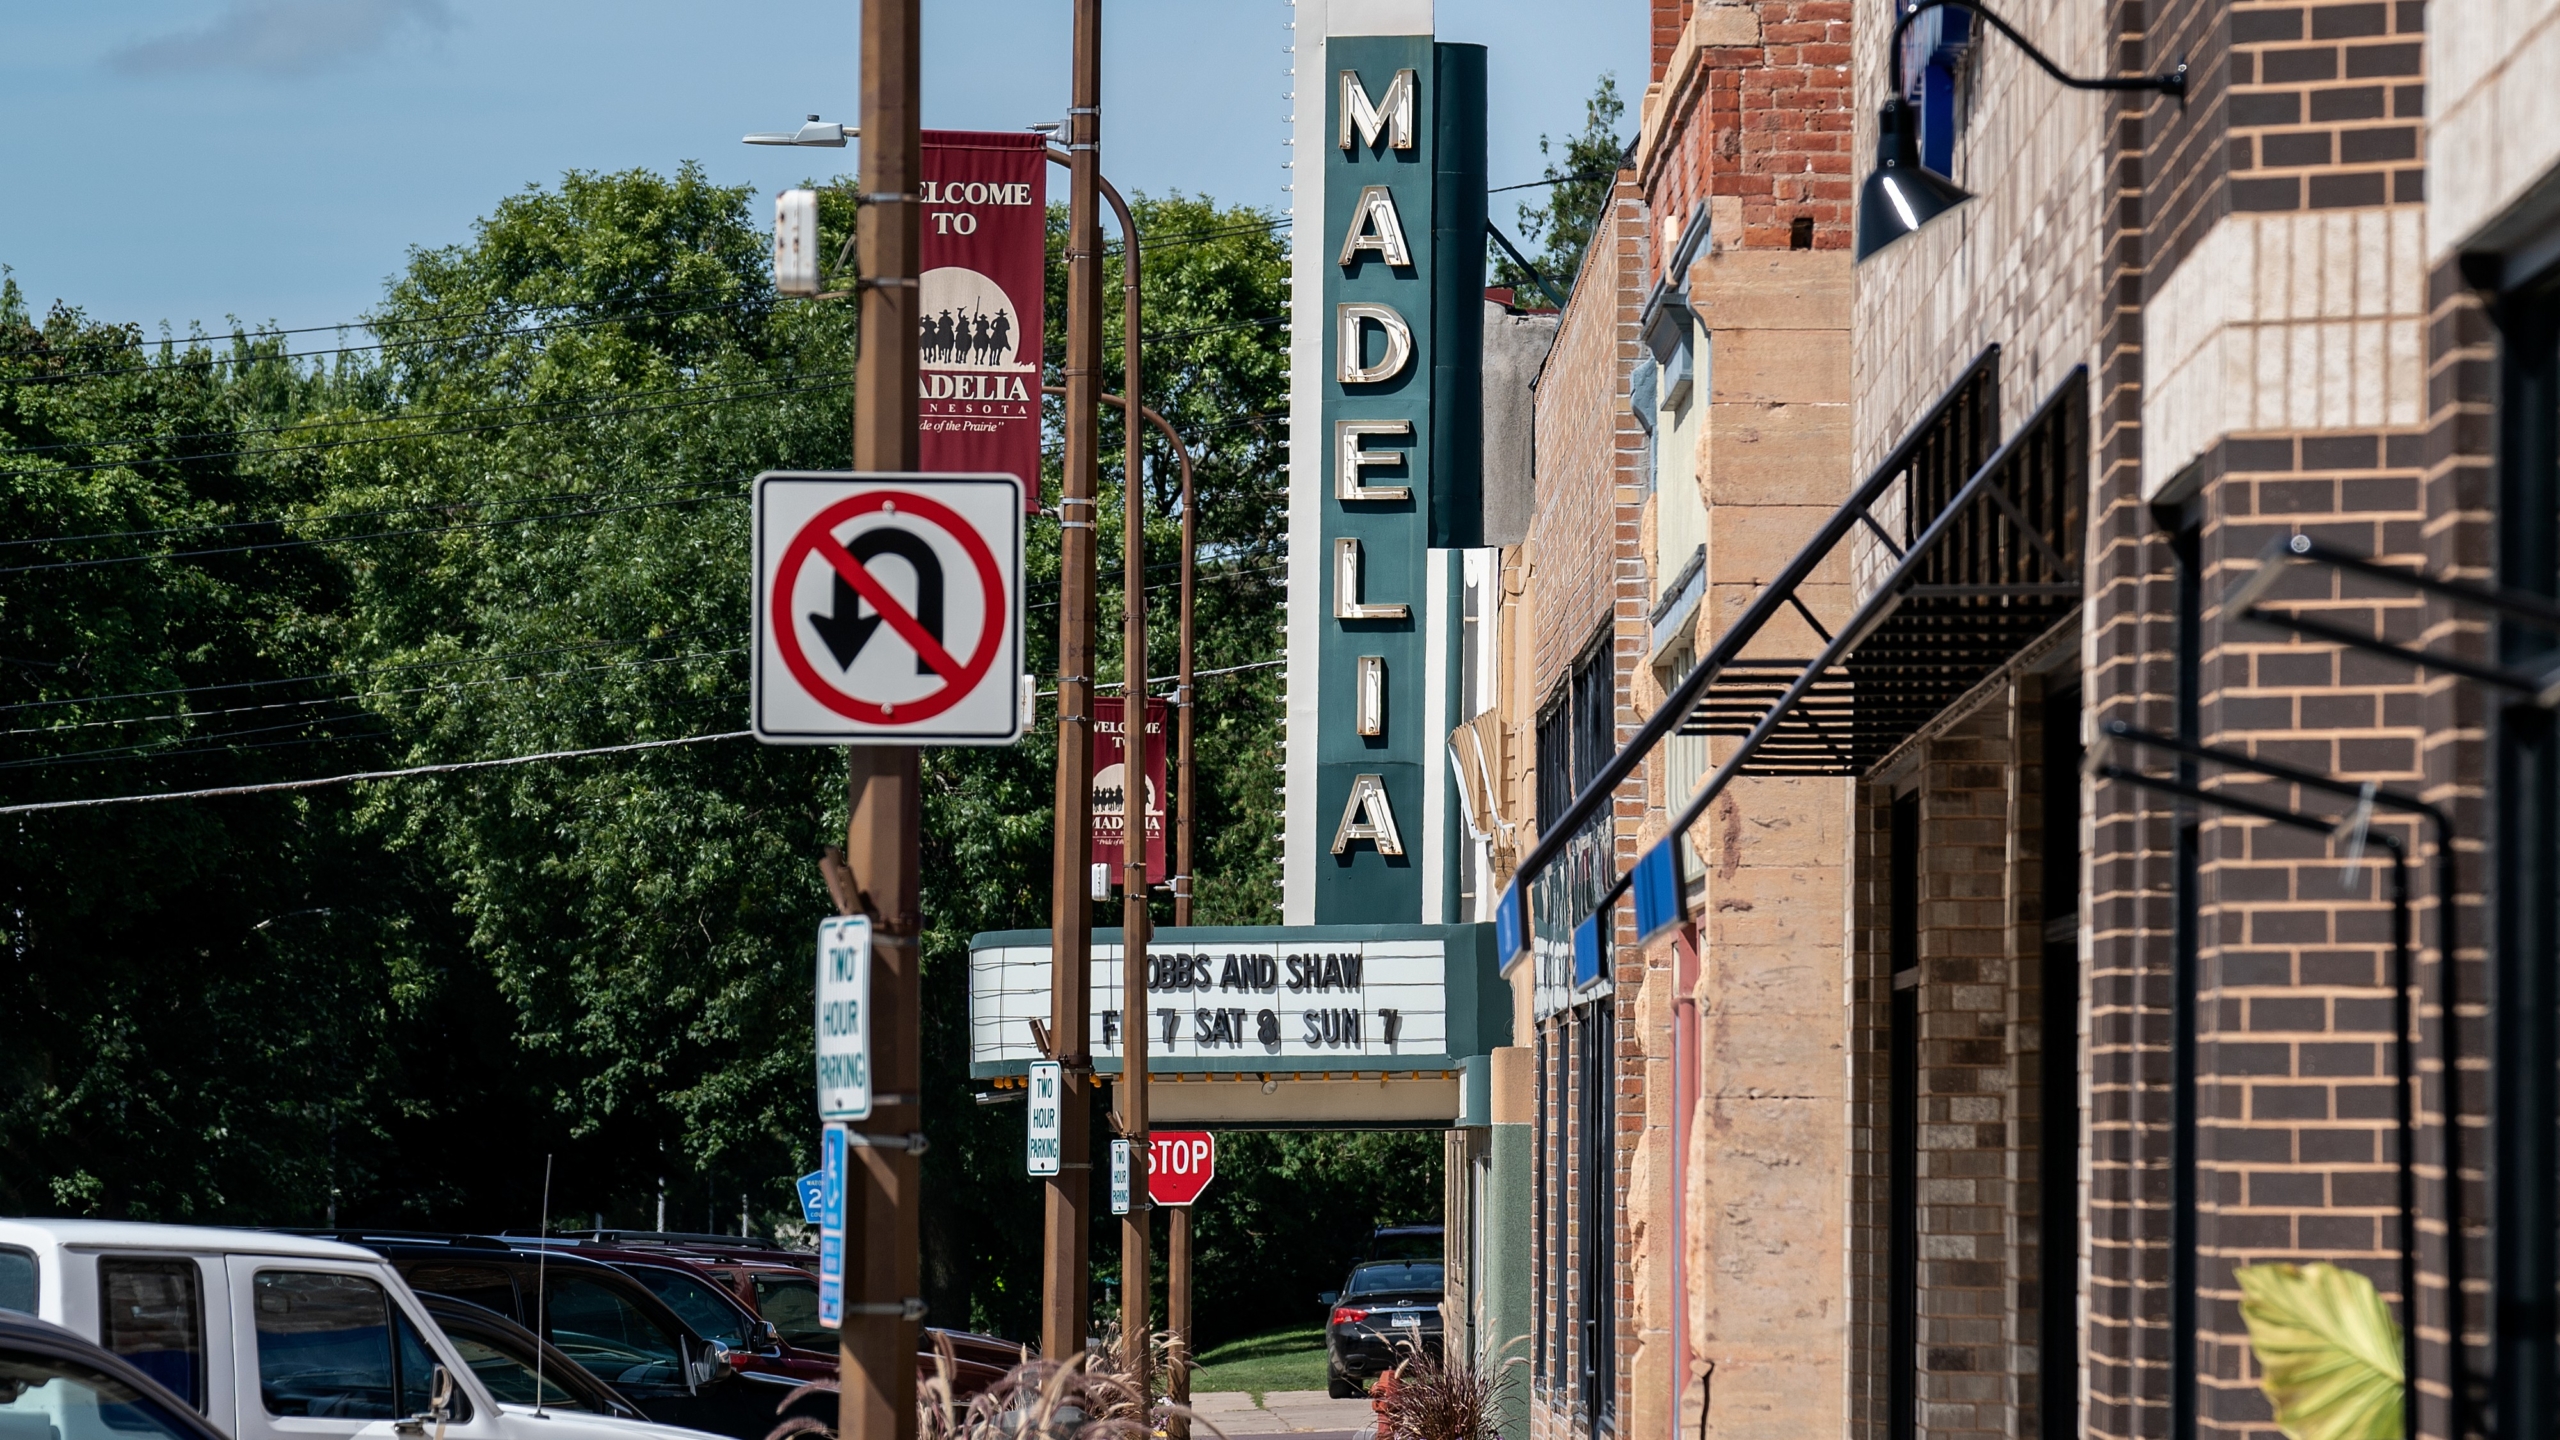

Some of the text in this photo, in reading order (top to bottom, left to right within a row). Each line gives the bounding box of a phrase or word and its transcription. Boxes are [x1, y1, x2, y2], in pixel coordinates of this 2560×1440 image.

[931, 212, 977, 235] TO
[929, 403, 1027, 415] NESOTA
[933, 420, 946, 433] of
[945, 421, 961, 431] the
[1331, 68, 1413, 856] MADELIA
[1112, 736, 1126, 749] T
[828, 947, 856, 983] TWO
[1146, 953, 1362, 989] OBBS AND SHAW
[822, 1000, 860, 1038] HOUR
[1156, 1007, 1177, 1044] 7
[1194, 1007, 1246, 1043] SAT
[1256, 1008, 1278, 1046] 8
[1302, 1008, 1359, 1044] SUN
[1378, 1008, 1399, 1045] 7
[819, 1053, 865, 1090] PARKING
[1036, 1078, 1053, 1099] TWO
[1033, 1108, 1055, 1129] HOUR
[1030, 1138, 1057, 1159] PARKING
[1115, 1151, 1125, 1160] TWO
[1113, 1170, 1127, 1184] HOUR
[808, 1188, 822, 1209] 2
[1112, 1189, 1128, 1203] PARKING
